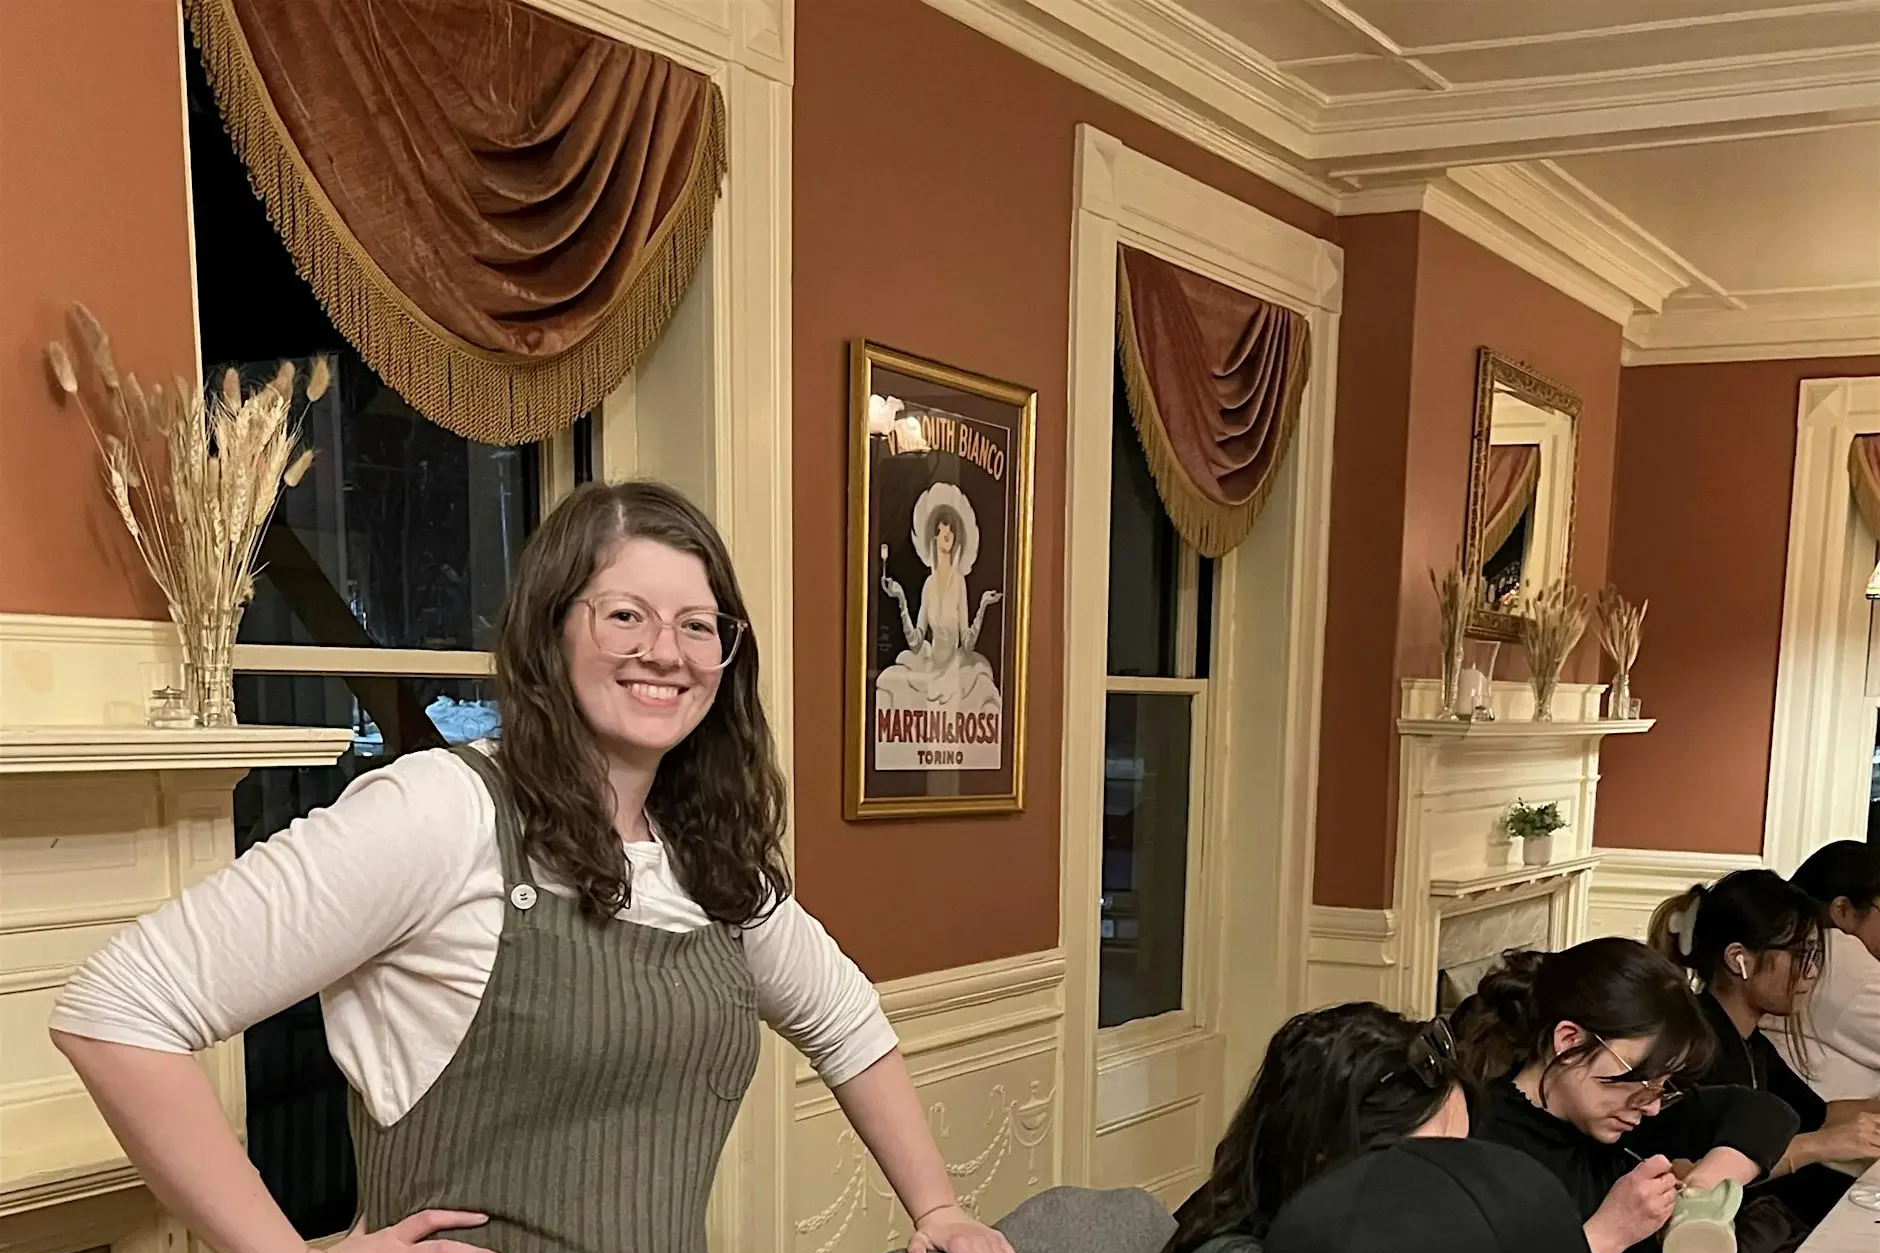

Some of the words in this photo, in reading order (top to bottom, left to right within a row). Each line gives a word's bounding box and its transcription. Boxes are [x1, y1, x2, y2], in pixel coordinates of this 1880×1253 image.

[887, 415, 955, 456] VOUTH
[959, 423, 1004, 480] BIANCO
[917, 750, 964, 765] TORINO
